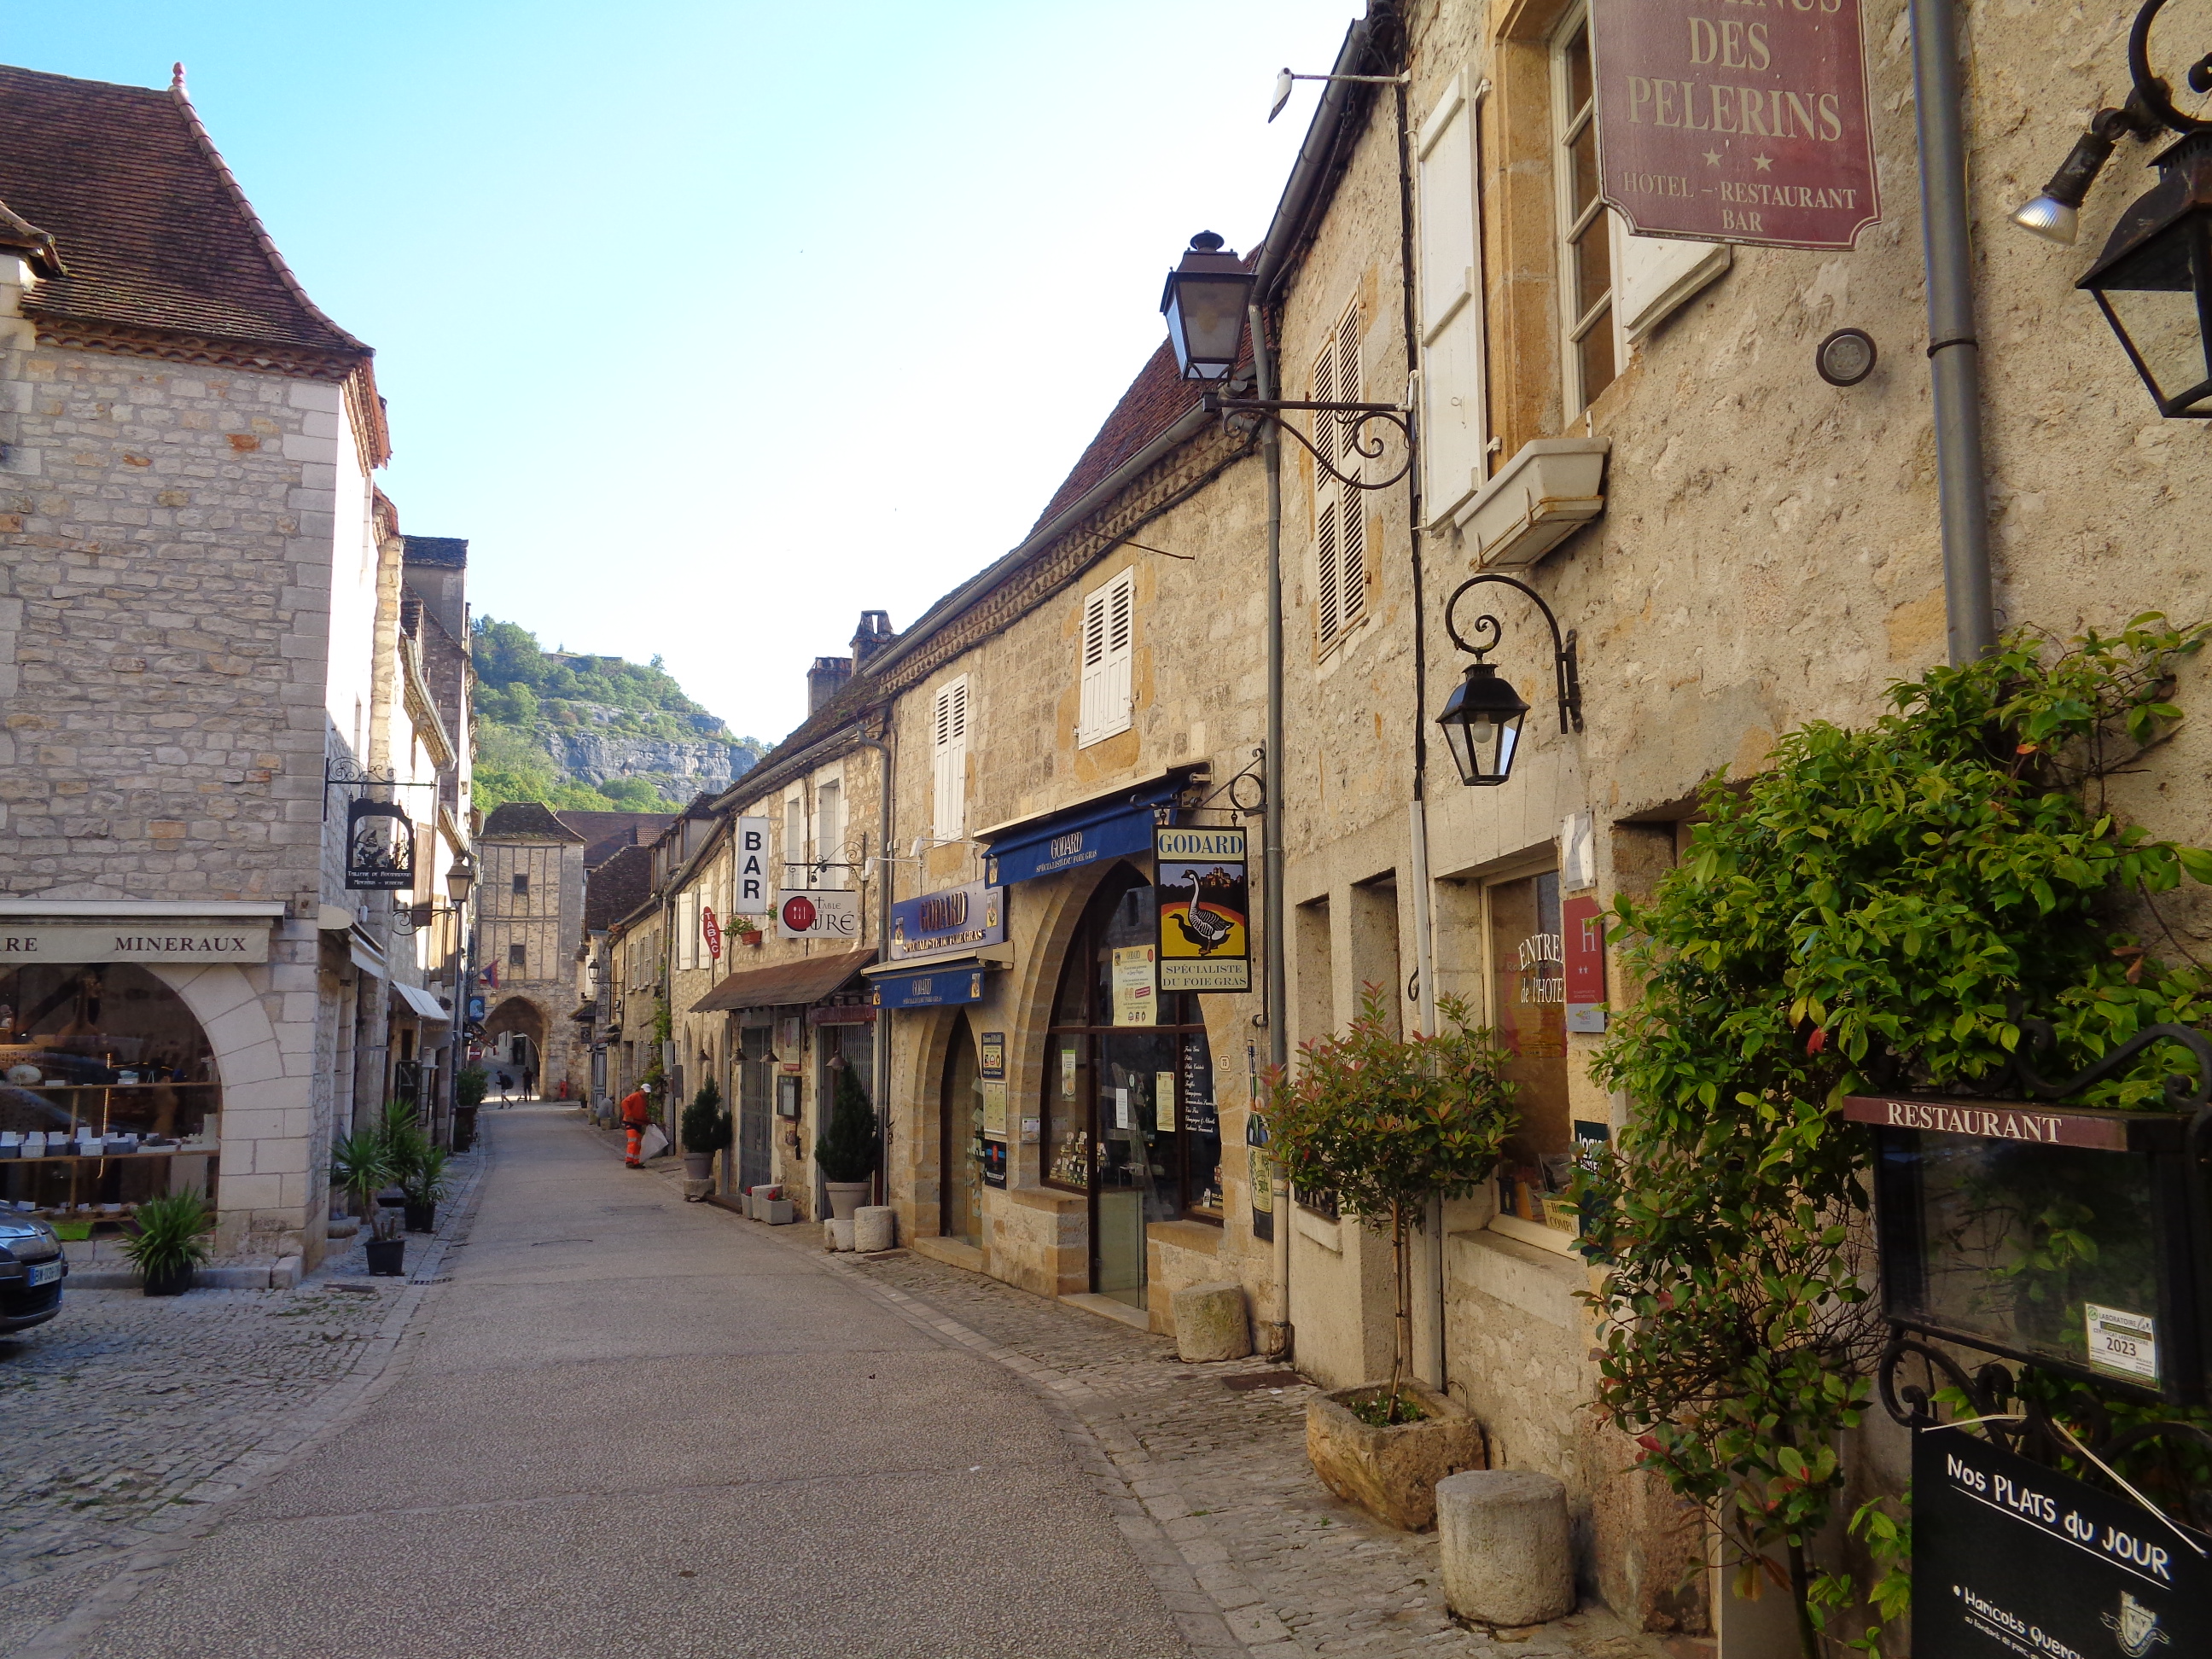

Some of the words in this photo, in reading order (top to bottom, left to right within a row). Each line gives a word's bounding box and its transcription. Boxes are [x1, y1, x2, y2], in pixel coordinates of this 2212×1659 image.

[1687, 17, 1771, 71] DES
[1625, 75, 1842, 142] PELERINS
[1624, 172, 1694, 198] HOTEL
[1720, 181, 1857, 209] RESTAURANT
[1722, 209, 1764, 232] BAR
[1051, 831, 1083, 859] GODARD
[1158, 834, 1244, 854] GODARD
[743, 831, 762, 899] BAR
[919, 891, 968, 933] GODARD
[0, 937, 38, 952] RE
[114, 936, 247, 952] MINERAUX
[705, 912, 719, 953] TABAC
[963, 928, 984, 942] GRAS
[1580, 918, 1597, 952] H
[1166, 963, 1243, 975] SPÉCIALISTE
[1518, 933, 1563, 972] ENTRE
[1162, 978, 1182, 987] DU
[1183, 977, 1212, 987] FOIE
[1214, 977, 1247, 986] GRAS
[1521, 977, 1529, 1004] de
[1533, 977, 1565, 1004] l'HOTE
[1886, 1102, 2063, 1144] RESTAURANT
[2099, 1313, 2137, 1328] LABORATOIRE
[2106, 1336, 2136, 1357] 2023
[1947, 1453, 1987, 1492] Nos
[1994, 1474, 2057, 1523] PLATS
[2064, 1510, 2093, 1541] du
[2102, 1526, 2171, 1580] JOUR
[1965, 1586, 2026, 1634] Haricots
